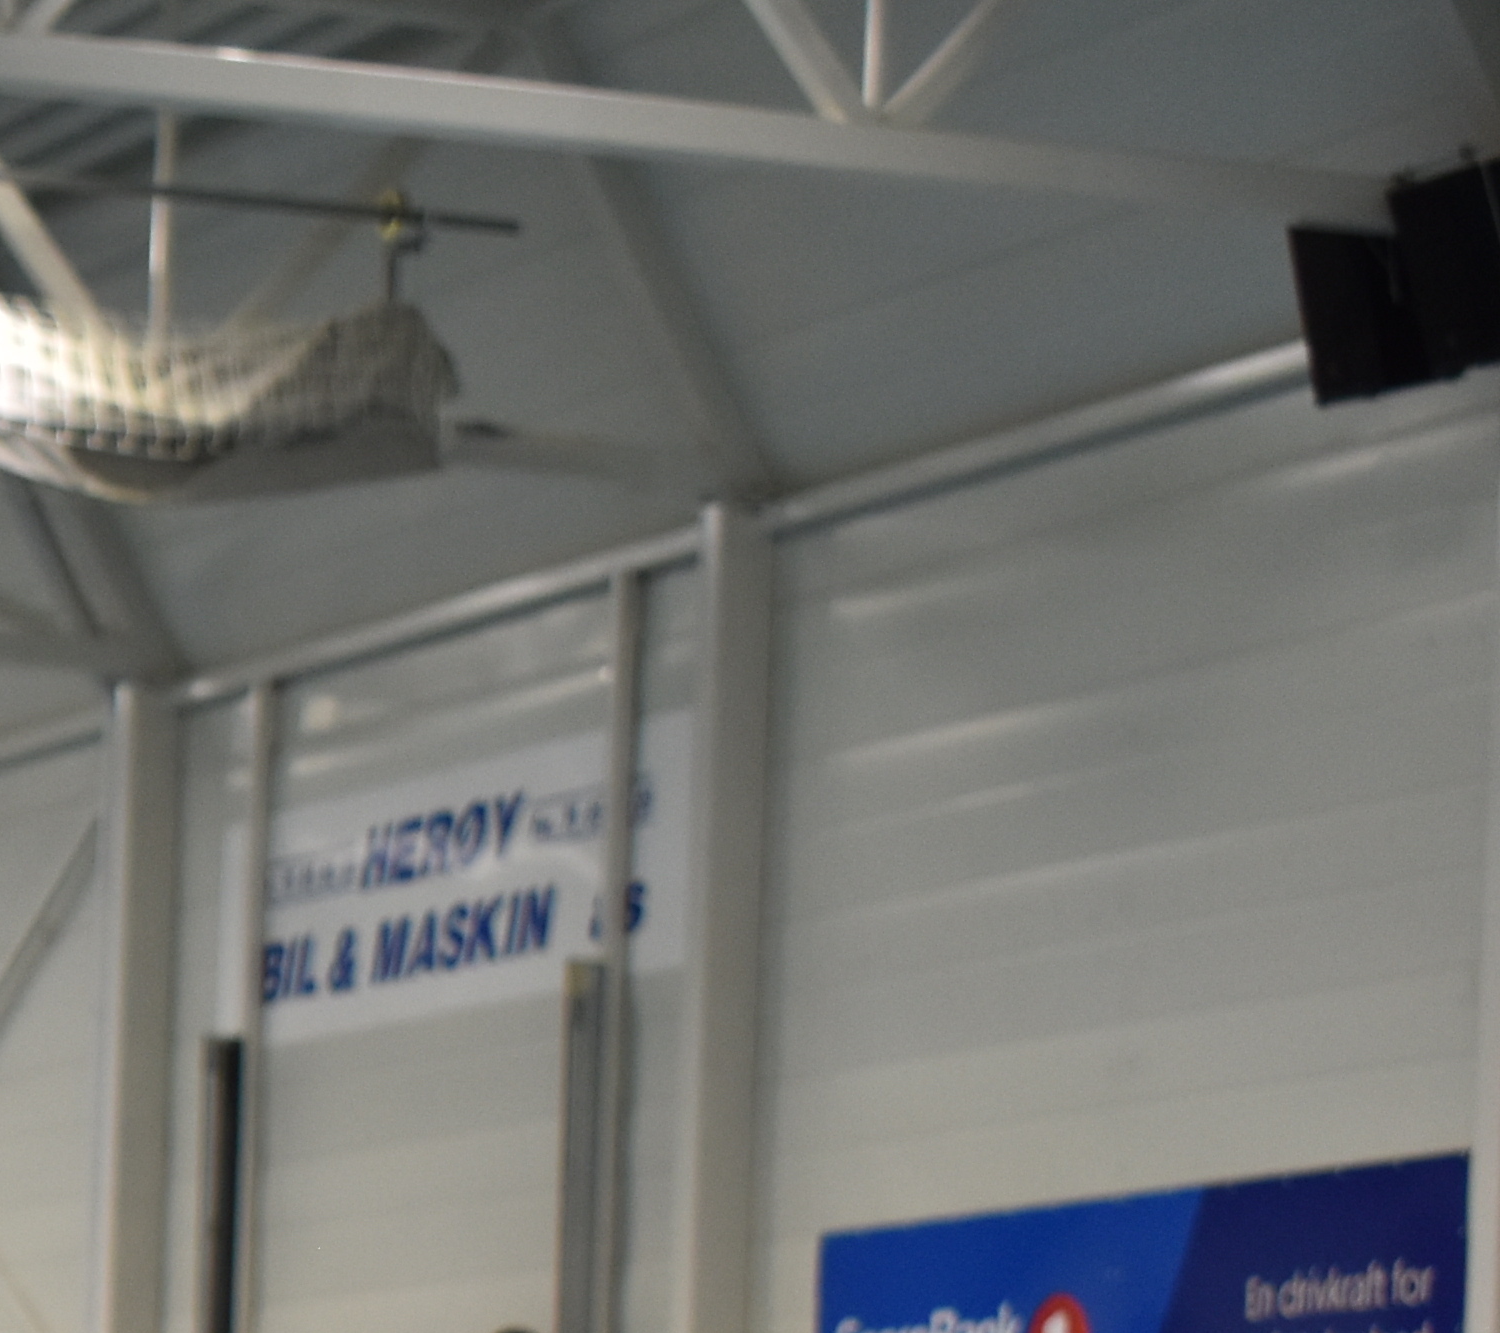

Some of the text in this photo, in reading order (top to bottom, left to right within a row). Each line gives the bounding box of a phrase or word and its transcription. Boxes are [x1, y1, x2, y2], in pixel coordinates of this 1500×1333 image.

[263, 934, 316, 1002] BIL
[330, 926, 357, 991] &
[371, 885, 556, 982] MASKIN
[1245, 1256, 1435, 1322] En drivkraft for
